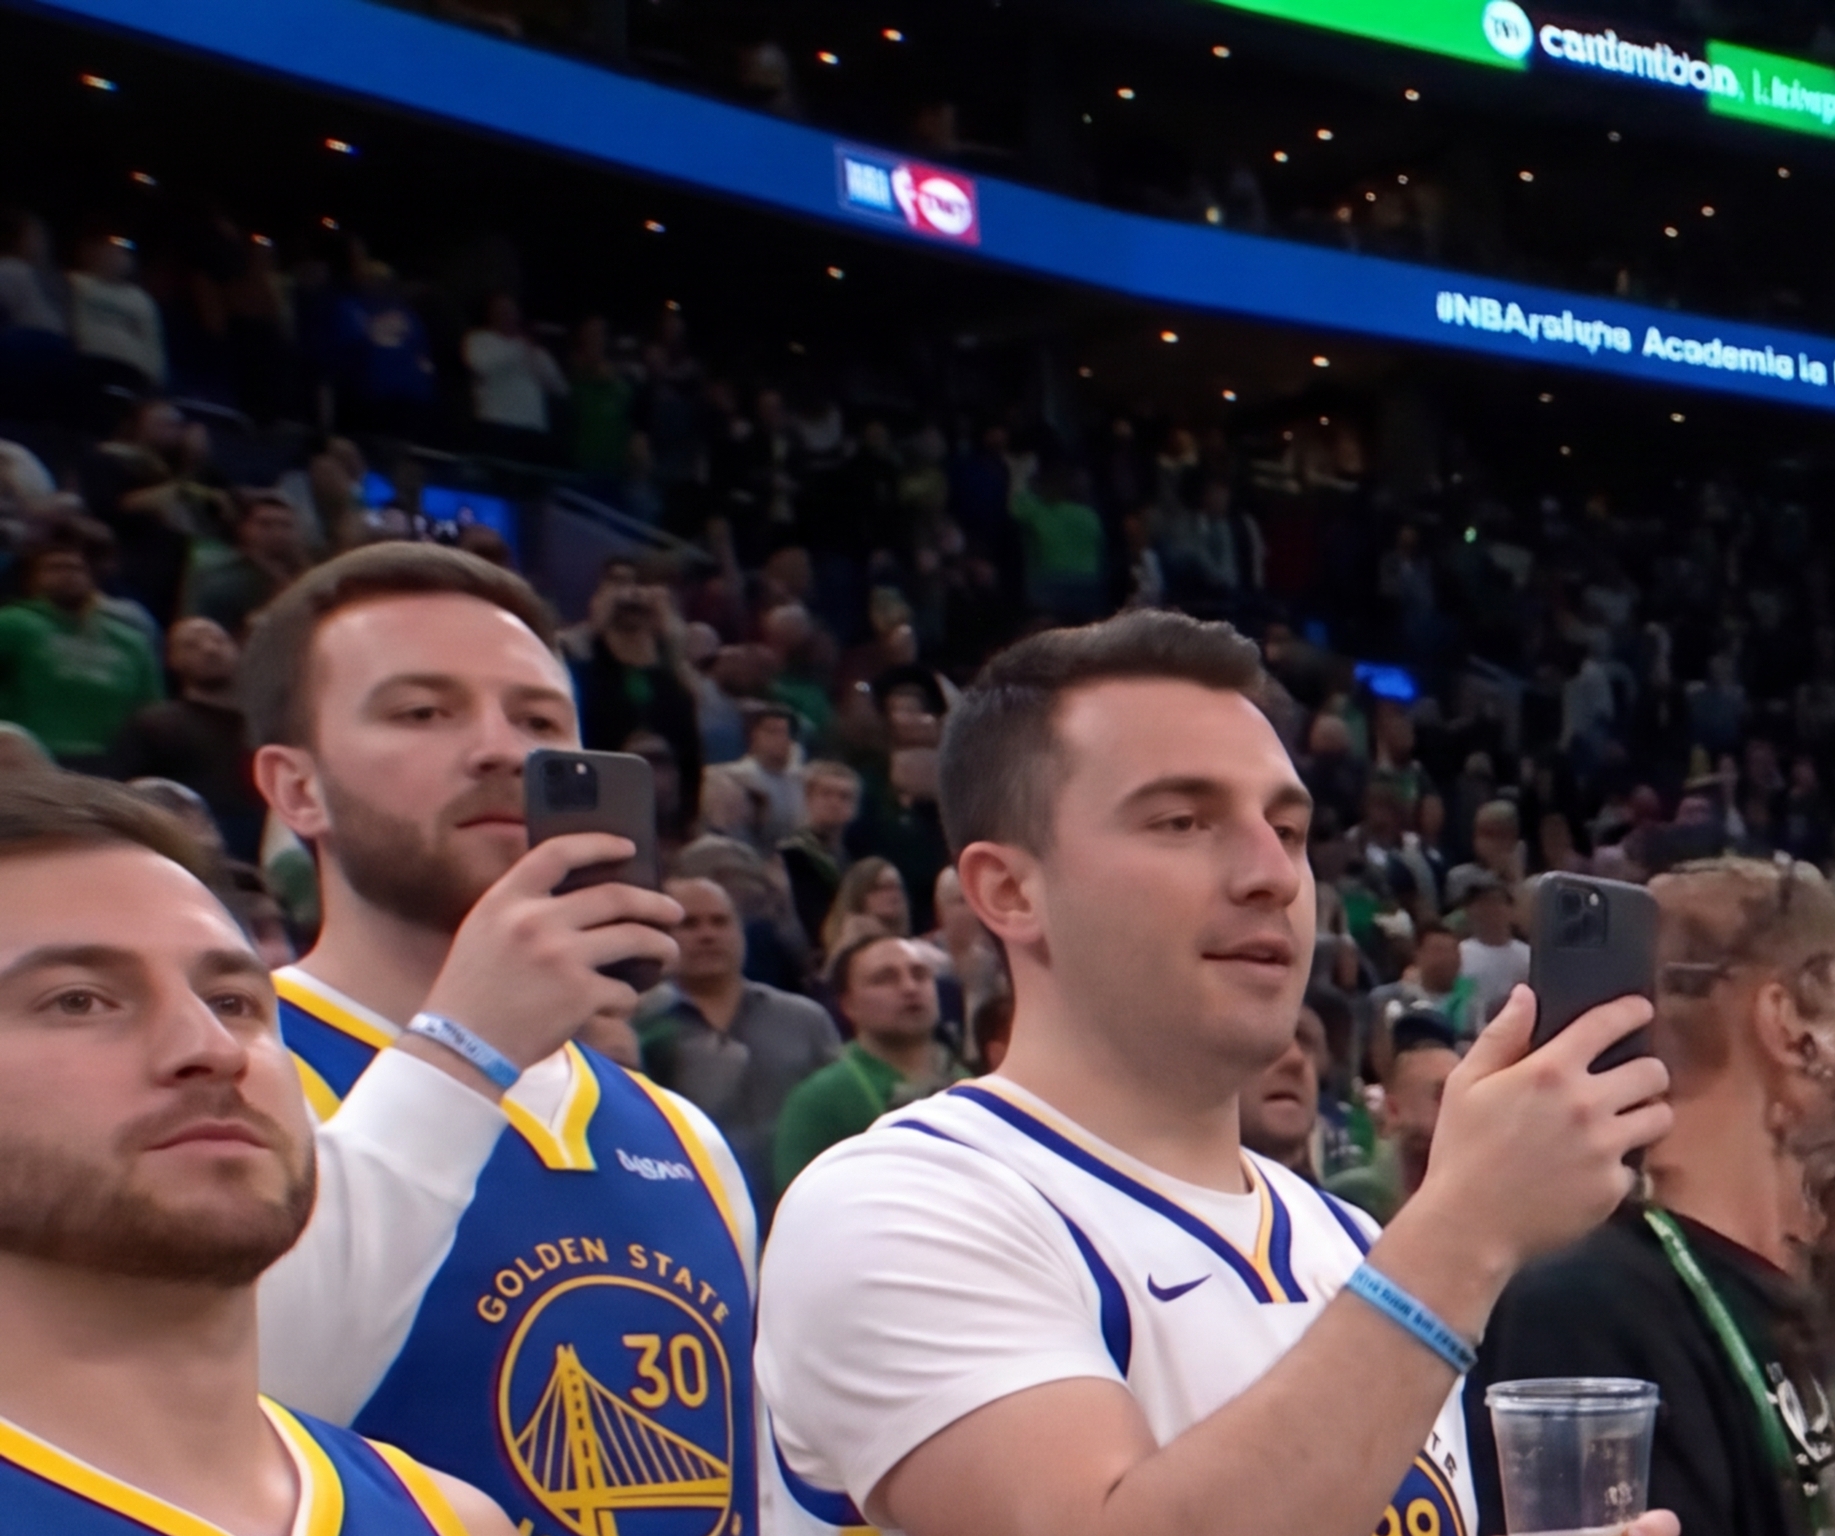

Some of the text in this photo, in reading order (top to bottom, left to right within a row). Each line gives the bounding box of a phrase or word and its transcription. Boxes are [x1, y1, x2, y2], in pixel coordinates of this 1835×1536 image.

[476, 1237, 730, 1325] GOLDEN STATE
[621, 1333, 709, 1409] 30
